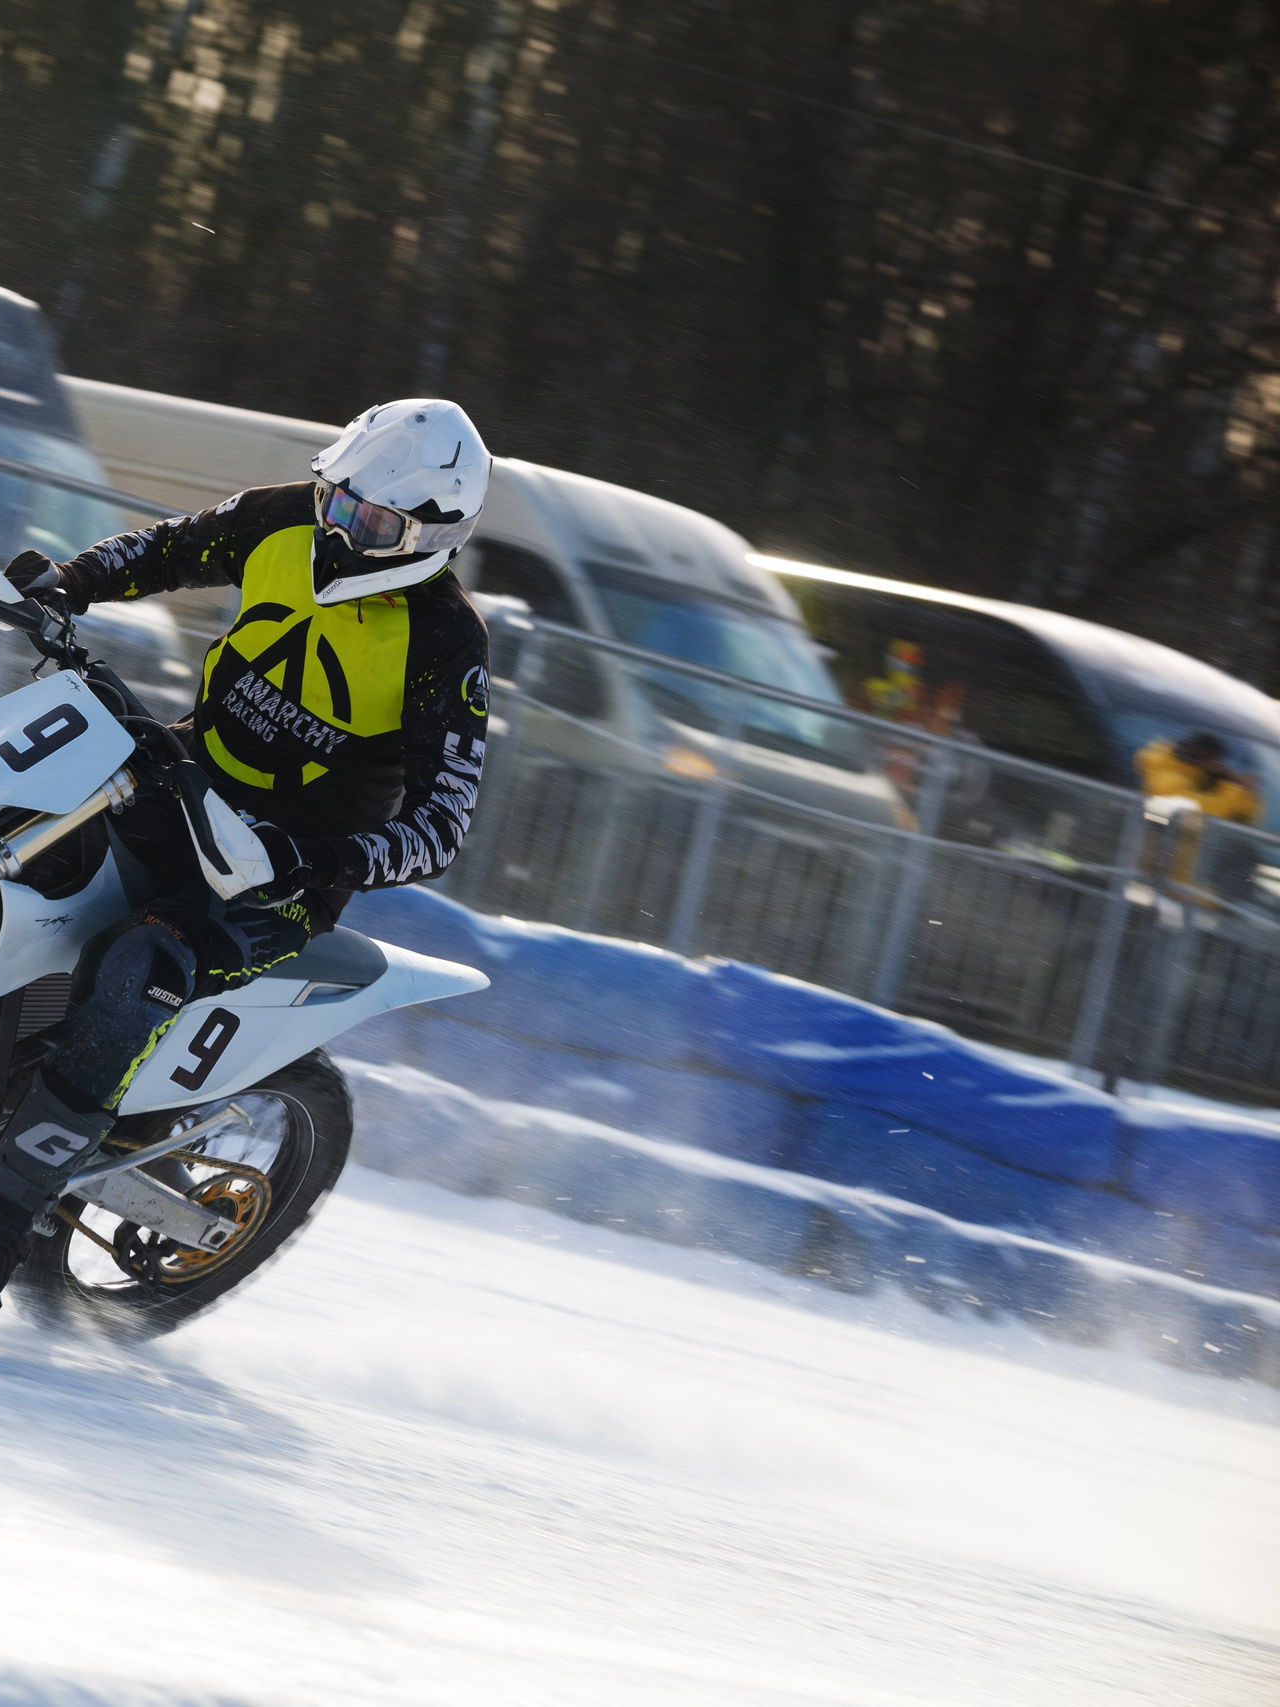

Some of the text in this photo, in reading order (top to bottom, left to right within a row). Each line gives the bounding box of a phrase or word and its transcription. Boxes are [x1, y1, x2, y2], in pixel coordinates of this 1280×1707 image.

[221, 688, 279, 743] RACING
[234, 669, 348, 754] ANARCHY
[348, 730, 487, 886] RACING
[169, 1006, 241, 1092] 9
